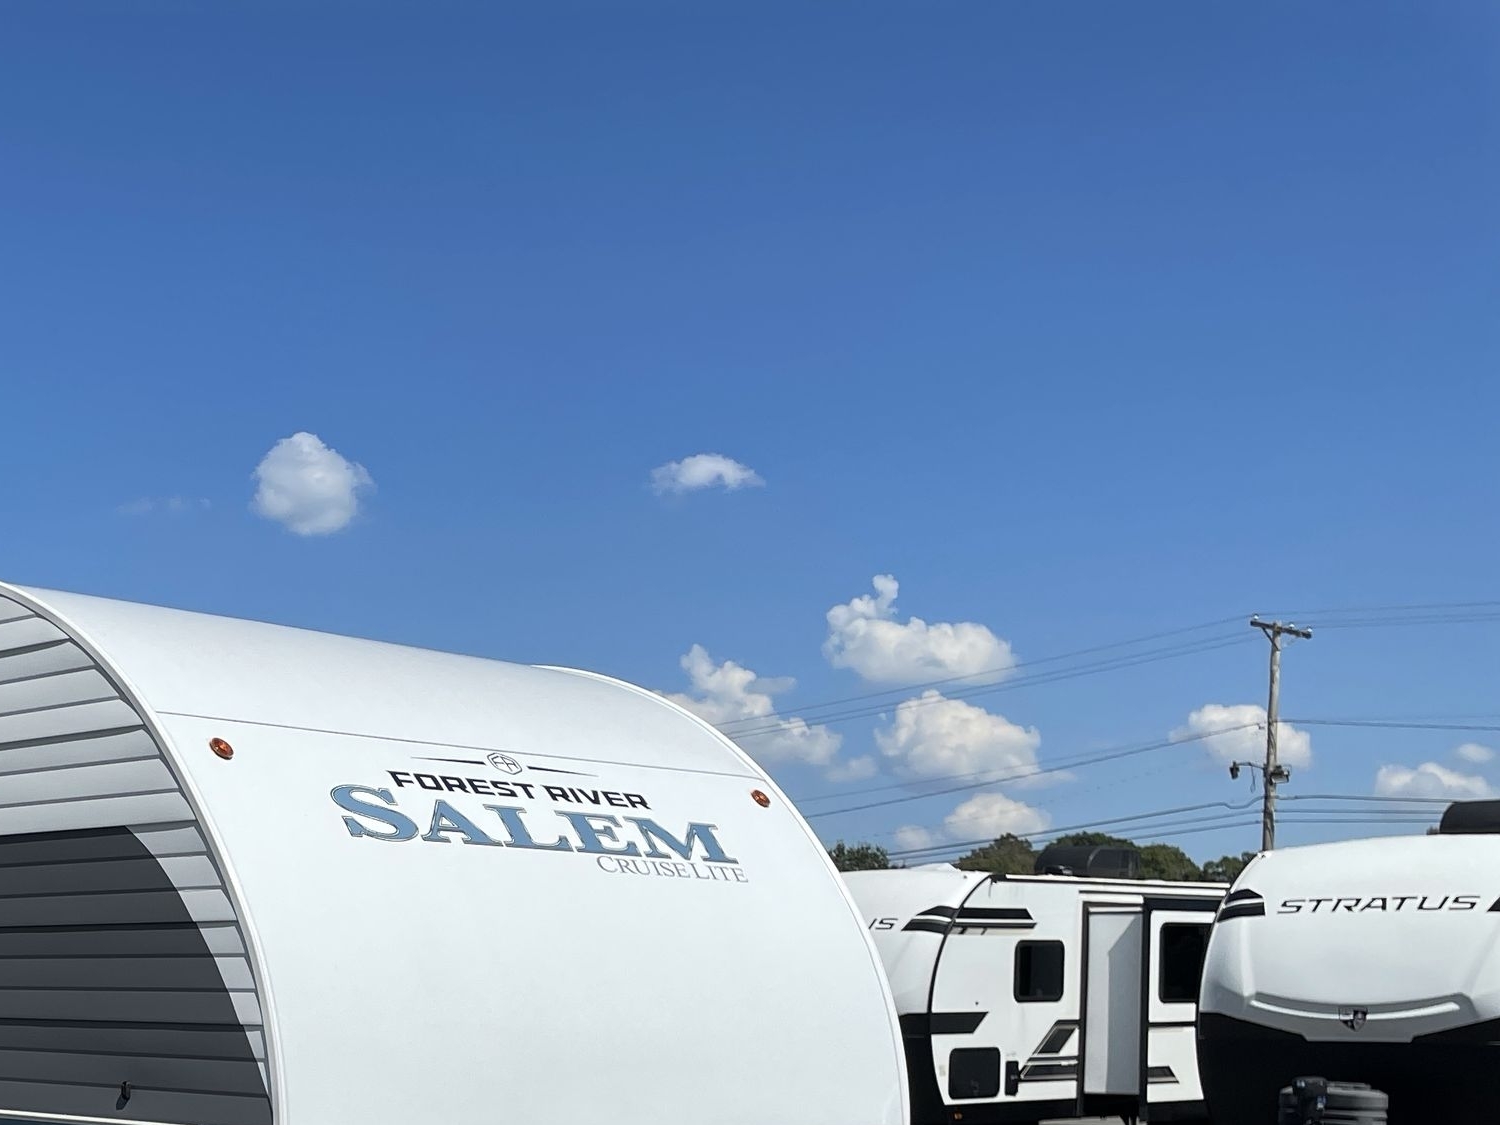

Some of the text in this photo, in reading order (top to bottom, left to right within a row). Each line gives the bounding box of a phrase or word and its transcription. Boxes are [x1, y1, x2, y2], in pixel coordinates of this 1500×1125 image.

[386, 770, 652, 810] FOREST RIVER
[329, 783, 740, 865] SALEM
[1277, 896, 1480, 914] STRATUS
